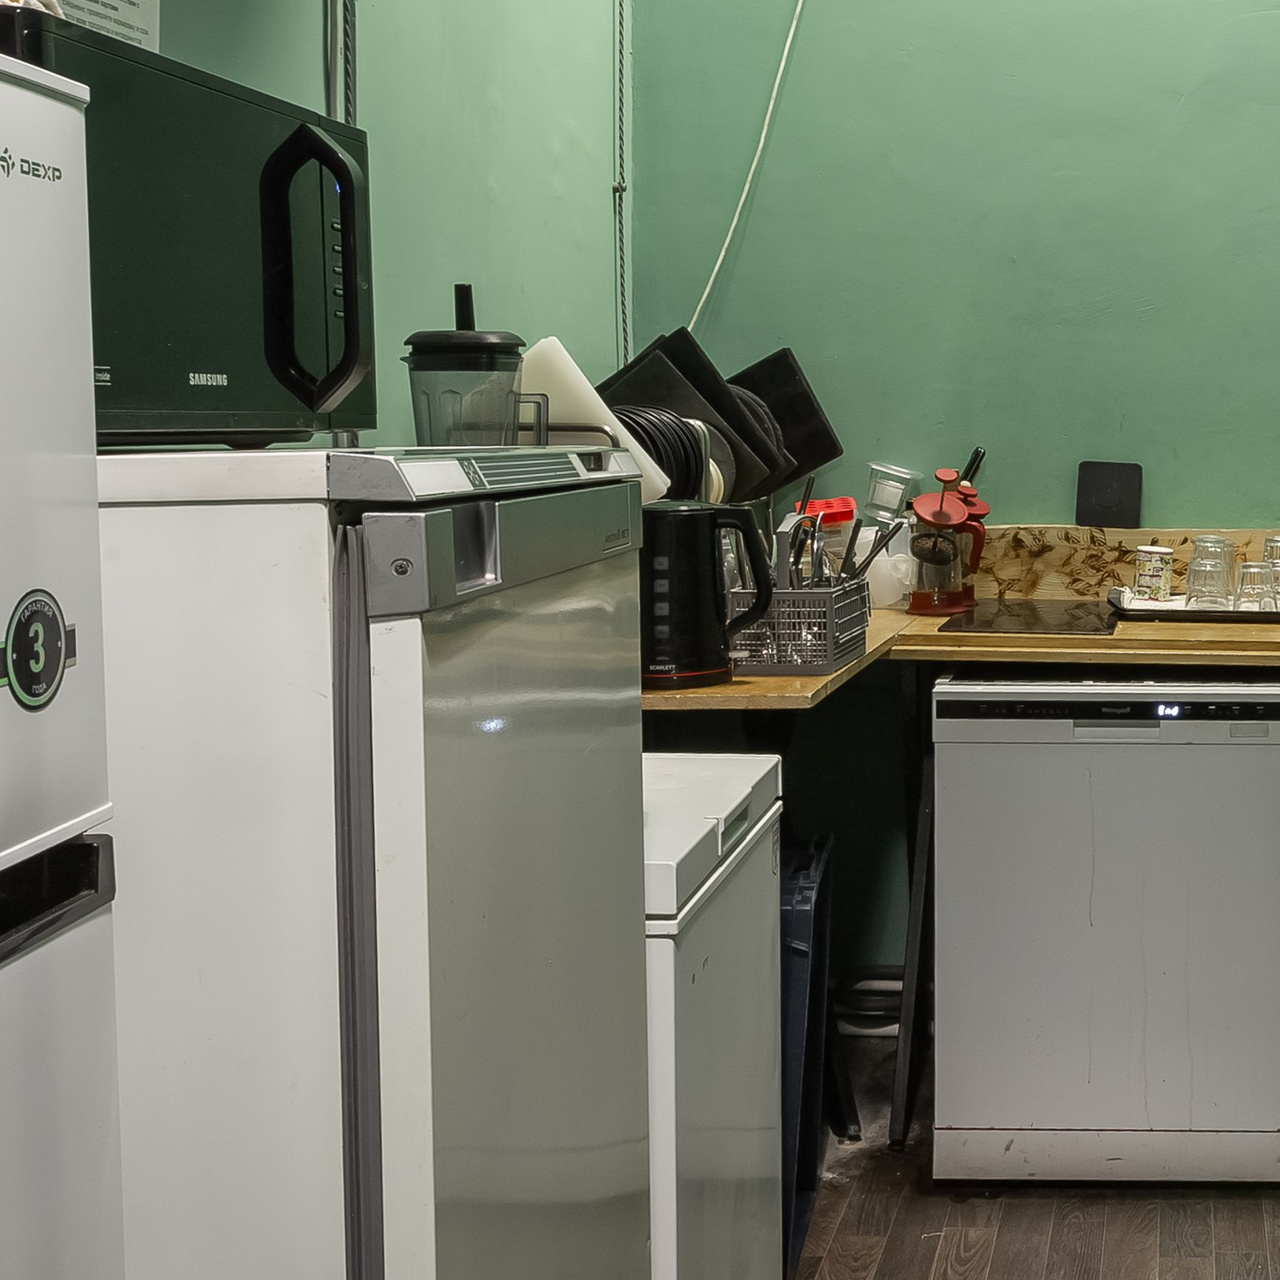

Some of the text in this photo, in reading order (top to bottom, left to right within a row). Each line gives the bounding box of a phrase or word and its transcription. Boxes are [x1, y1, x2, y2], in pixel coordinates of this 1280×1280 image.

[20, 158, 62, 182] DEXP
[189, 373, 228, 386] SAMSUNG
[20, 601, 54, 622] ГАРАНТИЯ
[28, 622, 45, 673] 3
